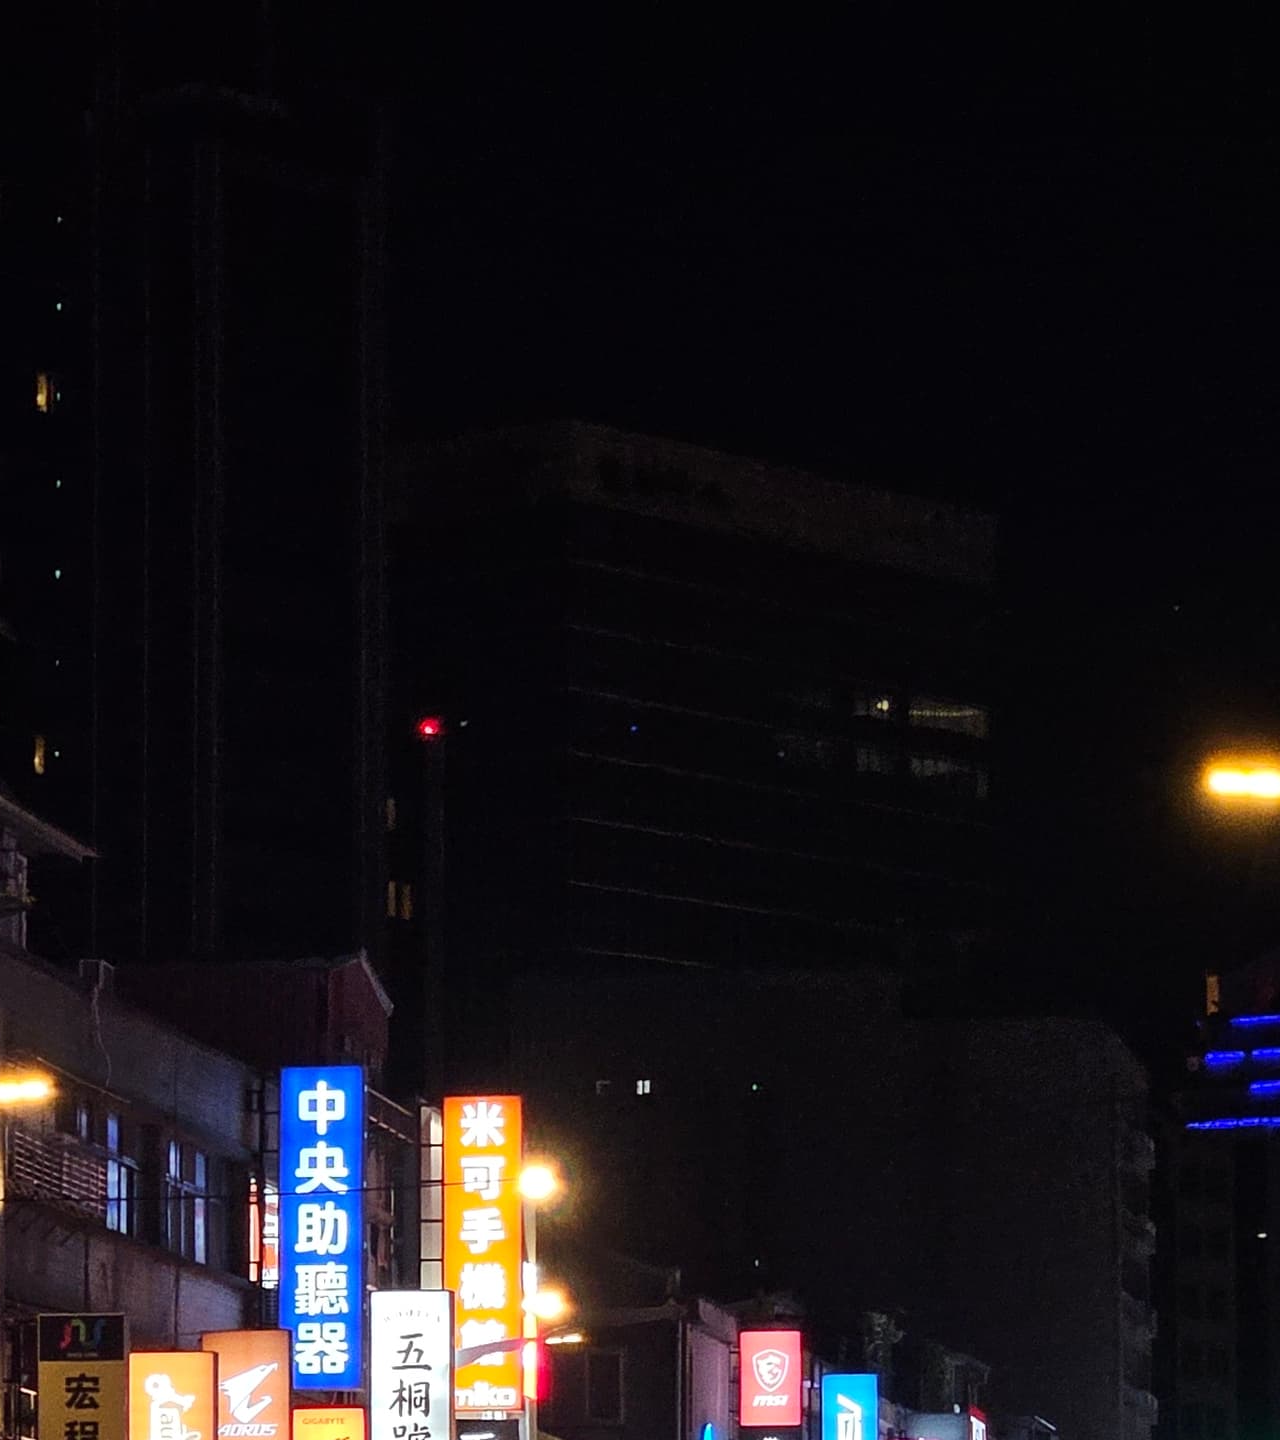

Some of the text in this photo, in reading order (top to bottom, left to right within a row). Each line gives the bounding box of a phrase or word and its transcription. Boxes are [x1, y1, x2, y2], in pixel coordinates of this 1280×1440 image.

[293, 1079, 349, 1375] 中央助聽器
[218, 1423, 279, 1437] AORUS
